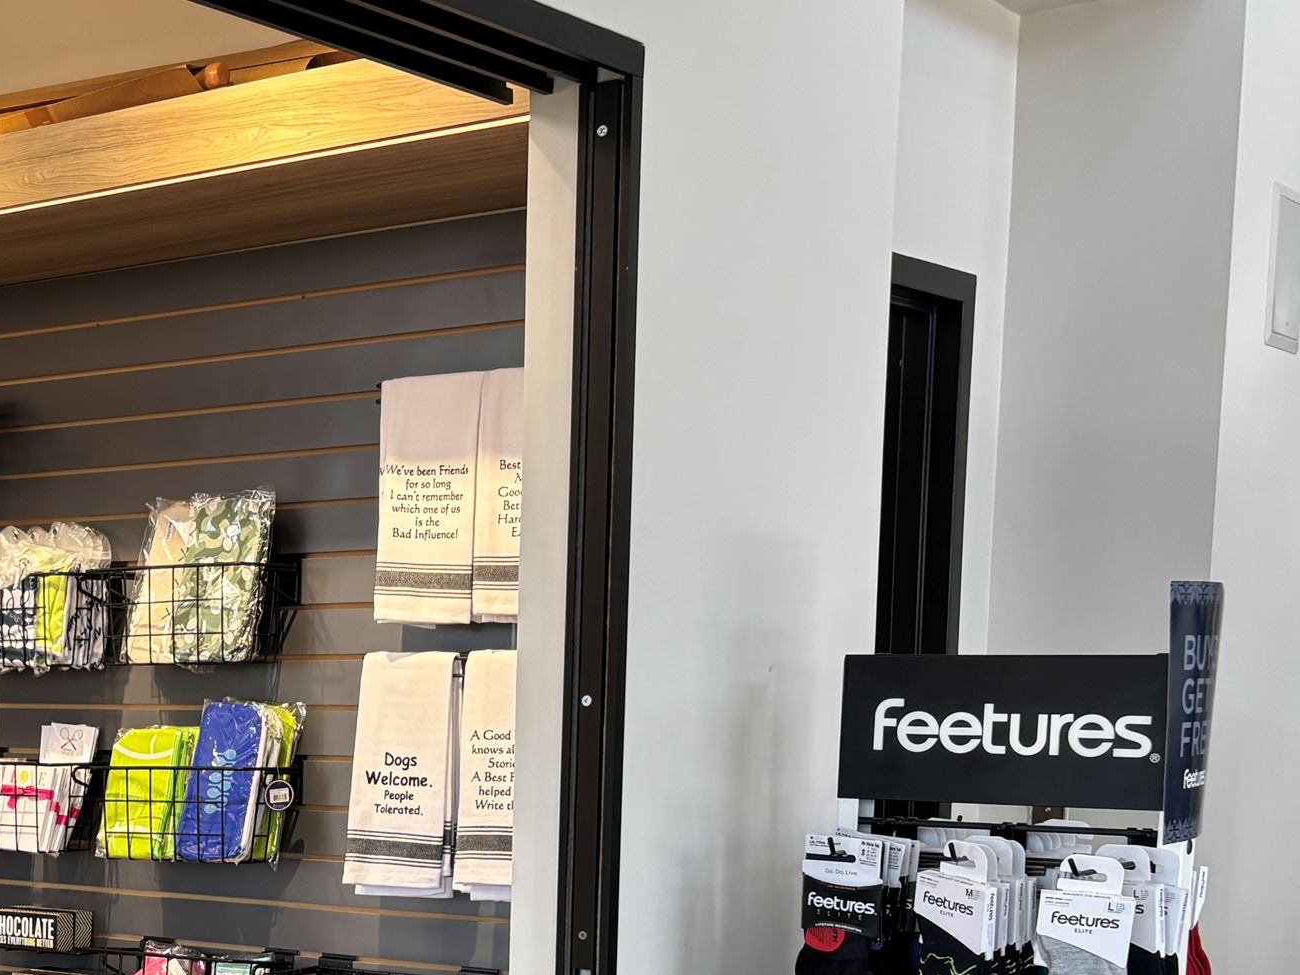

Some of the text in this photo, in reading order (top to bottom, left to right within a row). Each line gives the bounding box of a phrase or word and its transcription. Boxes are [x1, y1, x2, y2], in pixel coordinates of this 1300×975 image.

[387, 464, 468, 476] We've been Friends
[406, 479, 418, 490] for
[433, 479, 451, 489] long
[391, 490, 463, 500] I can't remember
[392, 504, 420, 513] which
[441, 504, 449, 515] of
[415, 517, 439, 526] is the
[393, 528, 458, 540] Bad Influence!
[470, 730, 511, 741] A Good
[472, 745, 503, 754] knows
[385, 752, 417, 770] Dogs
[366, 771, 433, 787] Welcome.
[471, 772, 507, 782] A Best
[384, 790, 414, 802] People
[479, 786, 511, 797] helped
[374, 804, 423, 816] Tolerated.
[475, 800, 503, 810] Write
[966, 889, 972, 897] M
[808, 892, 875, 914] feetures
[923, 891, 973, 915] feetures
[1108, 902, 1113, 911] L
[1051, 911, 1120, 929] feetures
[8, 936, 35, 947] EVERYTHING
[37, 939, 53, 948] BETTER
